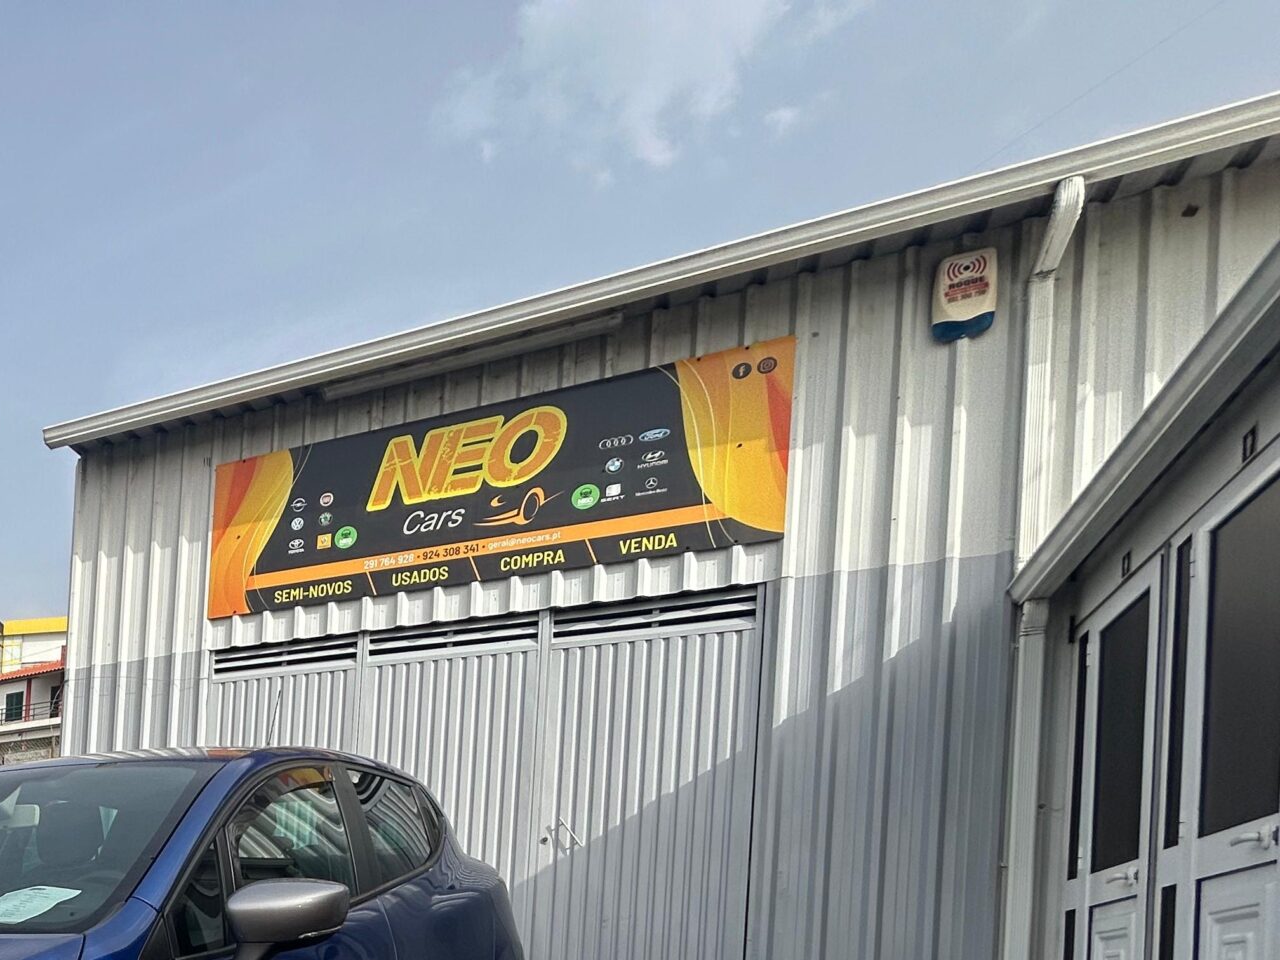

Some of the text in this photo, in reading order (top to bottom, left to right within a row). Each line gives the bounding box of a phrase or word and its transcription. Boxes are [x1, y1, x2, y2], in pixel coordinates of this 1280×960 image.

[366, 405, 568, 512] NEO
[600, 494, 625, 503] SEAT
[402, 508, 466, 535] Cars
[363, 559, 378, 570] 291
[397, 553, 414, 564] 928
[422, 550, 440, 560] 924
[442, 546, 461, 557] 308
[463, 543, 479, 554] 341
[487, 532, 561, 551] geral@neocars.pt
[619, 533, 678, 555] VENDA
[500, 549, 565, 571] COMPRA
[391, 566, 449, 587] USADOS
[274, 580, 352, 603] SEMI-NOVOS
